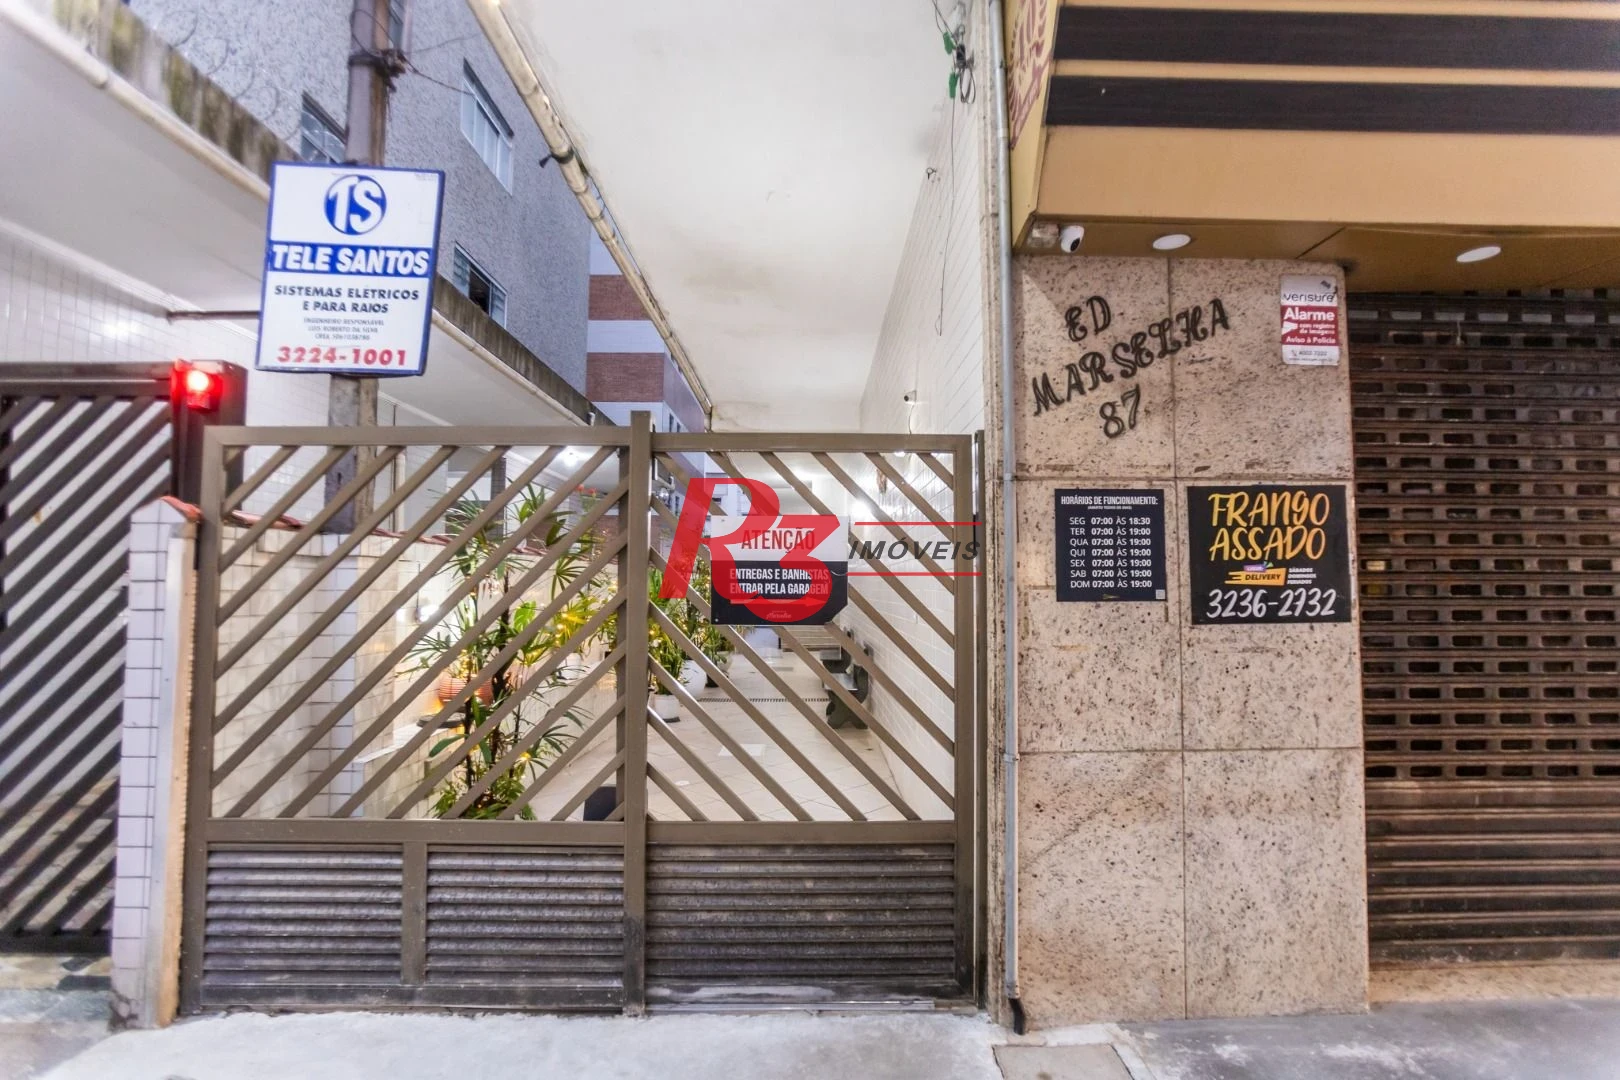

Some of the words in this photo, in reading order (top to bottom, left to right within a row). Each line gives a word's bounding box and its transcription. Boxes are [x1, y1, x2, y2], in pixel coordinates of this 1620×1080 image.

[272, 244, 331, 271] TELE
[336, 247, 429, 276] SANTOS
[275, 285, 342, 298] SISTEMAS
[1284, 293, 1334, 302] verisure
[303, 301, 309, 310] E
[313, 301, 347, 312] PARA
[351, 302, 389, 313] RAIOS
[1065, 295, 1112, 342] ED
[1284, 307, 1335, 320] Alarme
[277, 346, 406, 366] 3224-1001
[1032, 298, 1231, 417] MARSELHA
[1100, 384, 1141, 438] 87
[1061, 495, 1092, 505] HORÁRIOS
[1094, 496, 1102, 505] DE
[1103, 496, 1158, 505] FUNCIONAMENTO:
[1208, 490, 1330, 527] FRANGO
[742, 527, 814, 553] ATENÇÃO
[1209, 526, 1326, 561] ASSADO
[730, 569, 772, 580] ENTREGAS
[775, 569, 780, 580] E
[782, 569, 828, 580] BANHISTAS
[730, 583, 763, 594] ENTRAR
[765, 584, 786, 594] PELA
[788, 584, 828, 594] GARAGEM
[1206, 588, 1337, 618] 3236-2732
